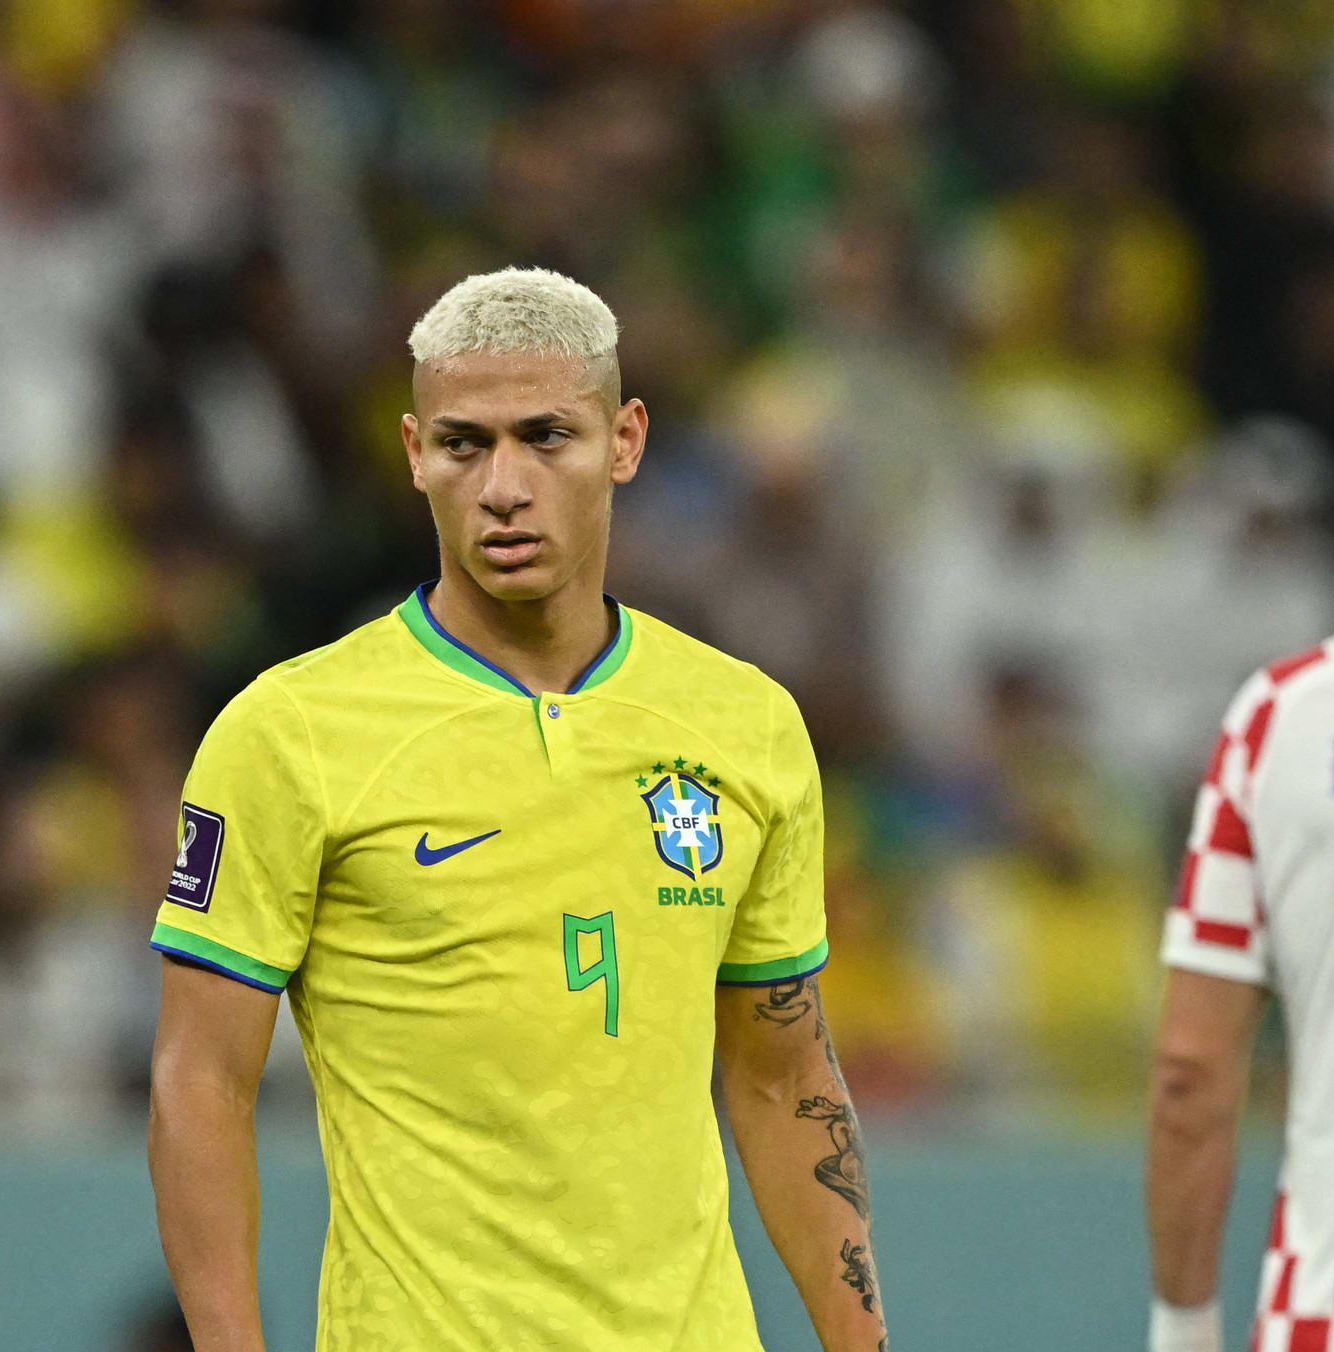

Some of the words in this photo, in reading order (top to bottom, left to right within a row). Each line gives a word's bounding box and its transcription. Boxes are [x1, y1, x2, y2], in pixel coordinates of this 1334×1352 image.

[672, 816, 700, 830] CBF
[658, 886, 726, 907] BRASIL
[563, 911, 619, 1038] 9
